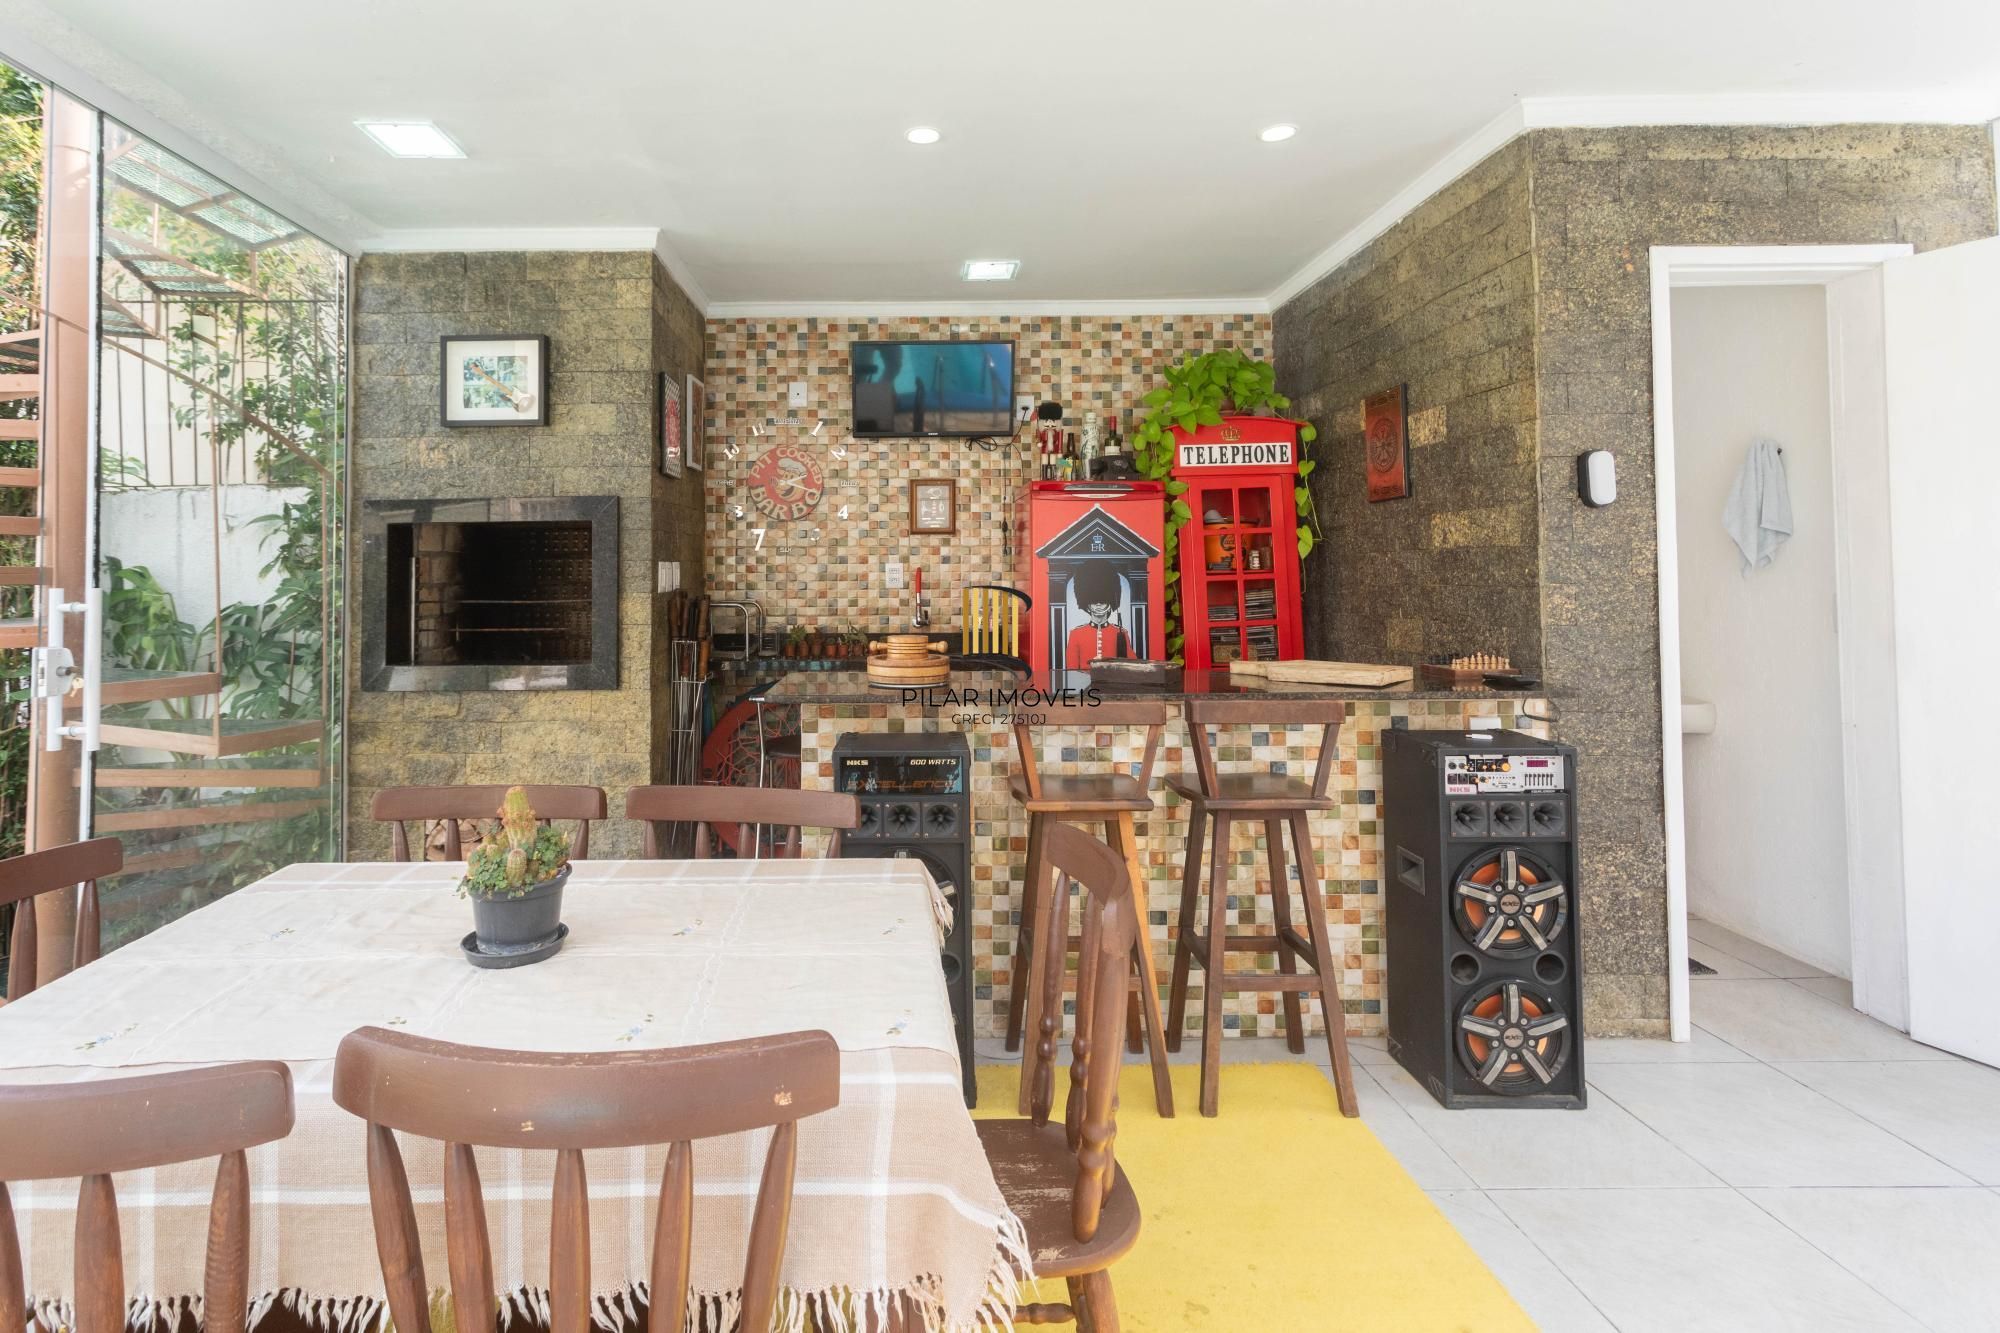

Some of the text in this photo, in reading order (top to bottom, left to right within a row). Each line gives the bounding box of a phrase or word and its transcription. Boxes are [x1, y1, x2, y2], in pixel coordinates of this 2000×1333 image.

[1183, 444, 1289, 465] TELEPHONE
[750, 447, 823, 485] PIT COOKED
[838, 504, 849, 520] 4
[750, 528, 766, 552] 7
[928, 758, 957, 766] WATTS
